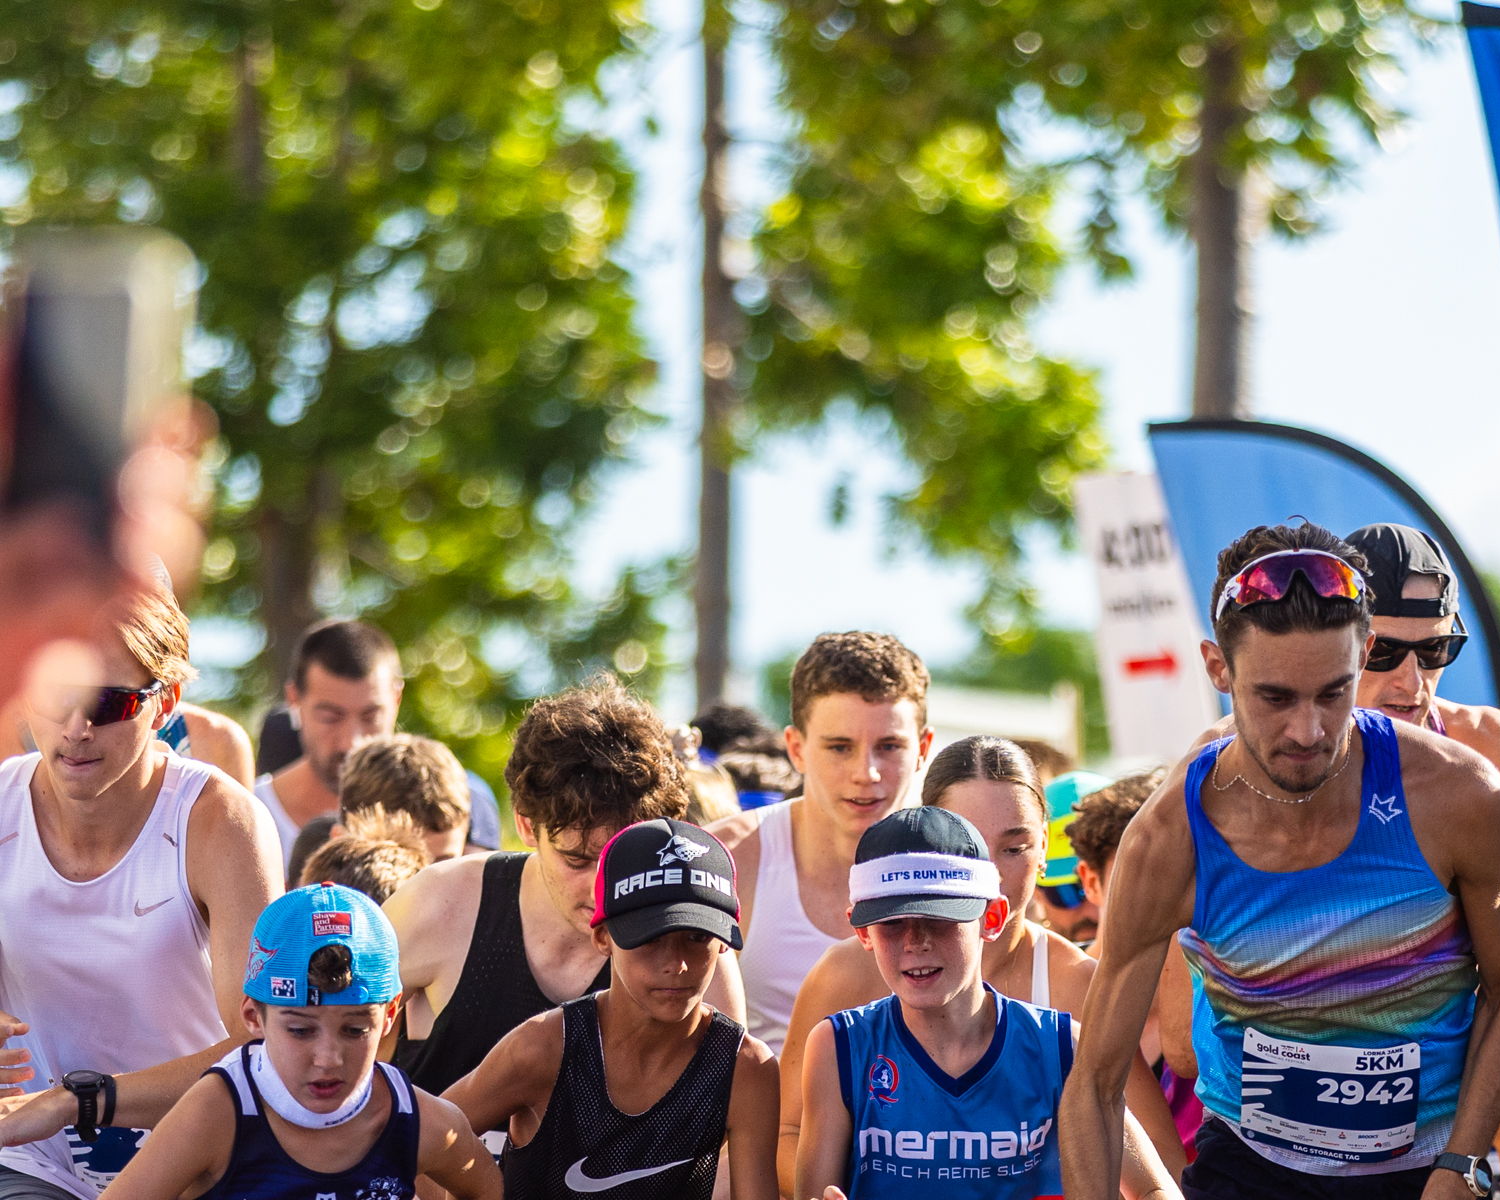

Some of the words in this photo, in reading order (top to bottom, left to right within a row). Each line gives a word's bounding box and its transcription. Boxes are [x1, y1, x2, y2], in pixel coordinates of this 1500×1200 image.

[614, 868, 683, 900] RACE
[690, 869, 731, 897] ONE
[881, 871, 910, 883] LET'S
[913, 870, 937, 880] RUN
[315, 924, 350, 932] Partners
[1256, 1043, 1279, 1056] gold
[1281, 1051, 1311, 1061] coast
[1355, 1053, 1404, 1071] 5KM
[1316, 1077, 1414, 1105] 2942
[859, 1118, 1053, 1160] mermaid
[1292, 1144, 1308, 1152] BAG
[1309, 1148, 1343, 1159] STORAGE
[1344, 1153, 1360, 1161] TAG
[860, 1158, 930, 1179] BEACH
[938, 1166, 991, 1180] AEME
